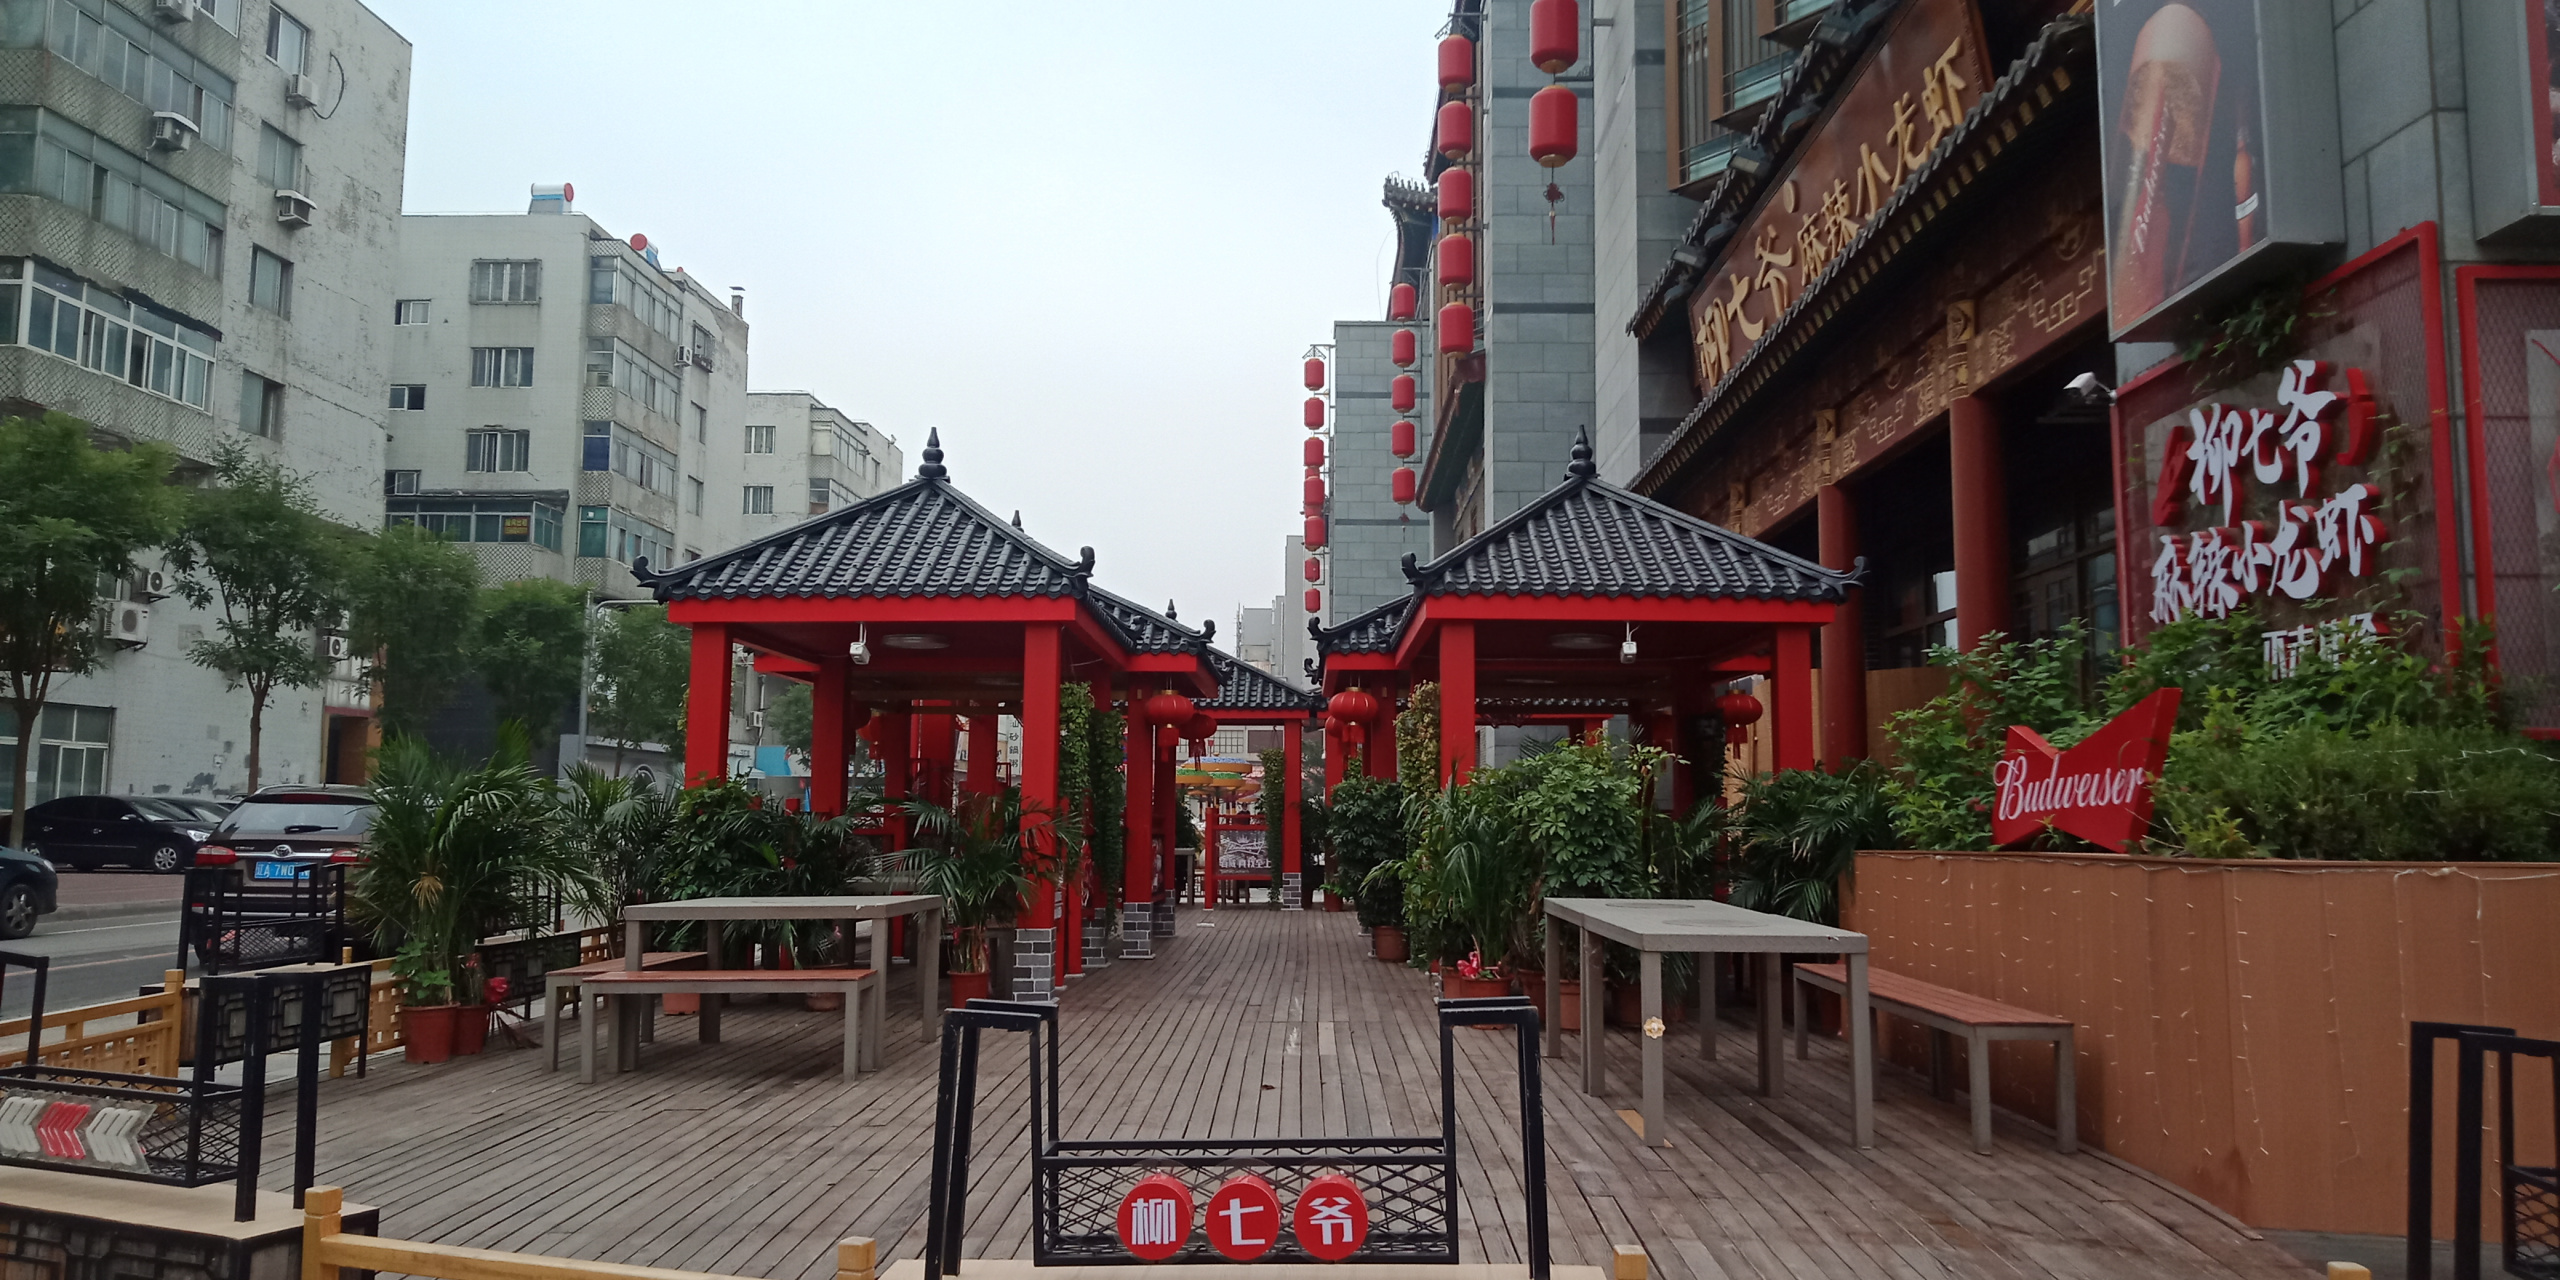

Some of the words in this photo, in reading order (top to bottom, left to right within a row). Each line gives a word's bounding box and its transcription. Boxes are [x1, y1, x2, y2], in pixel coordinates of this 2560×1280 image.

[2186, 360, 2337, 528] 柳七爷
[2149, 484, 2375, 624] 麻辣小龙虾
[1993, 754, 2145, 821] Budweiser
[1131, 1197, 1353, 1245] 柳七爷
